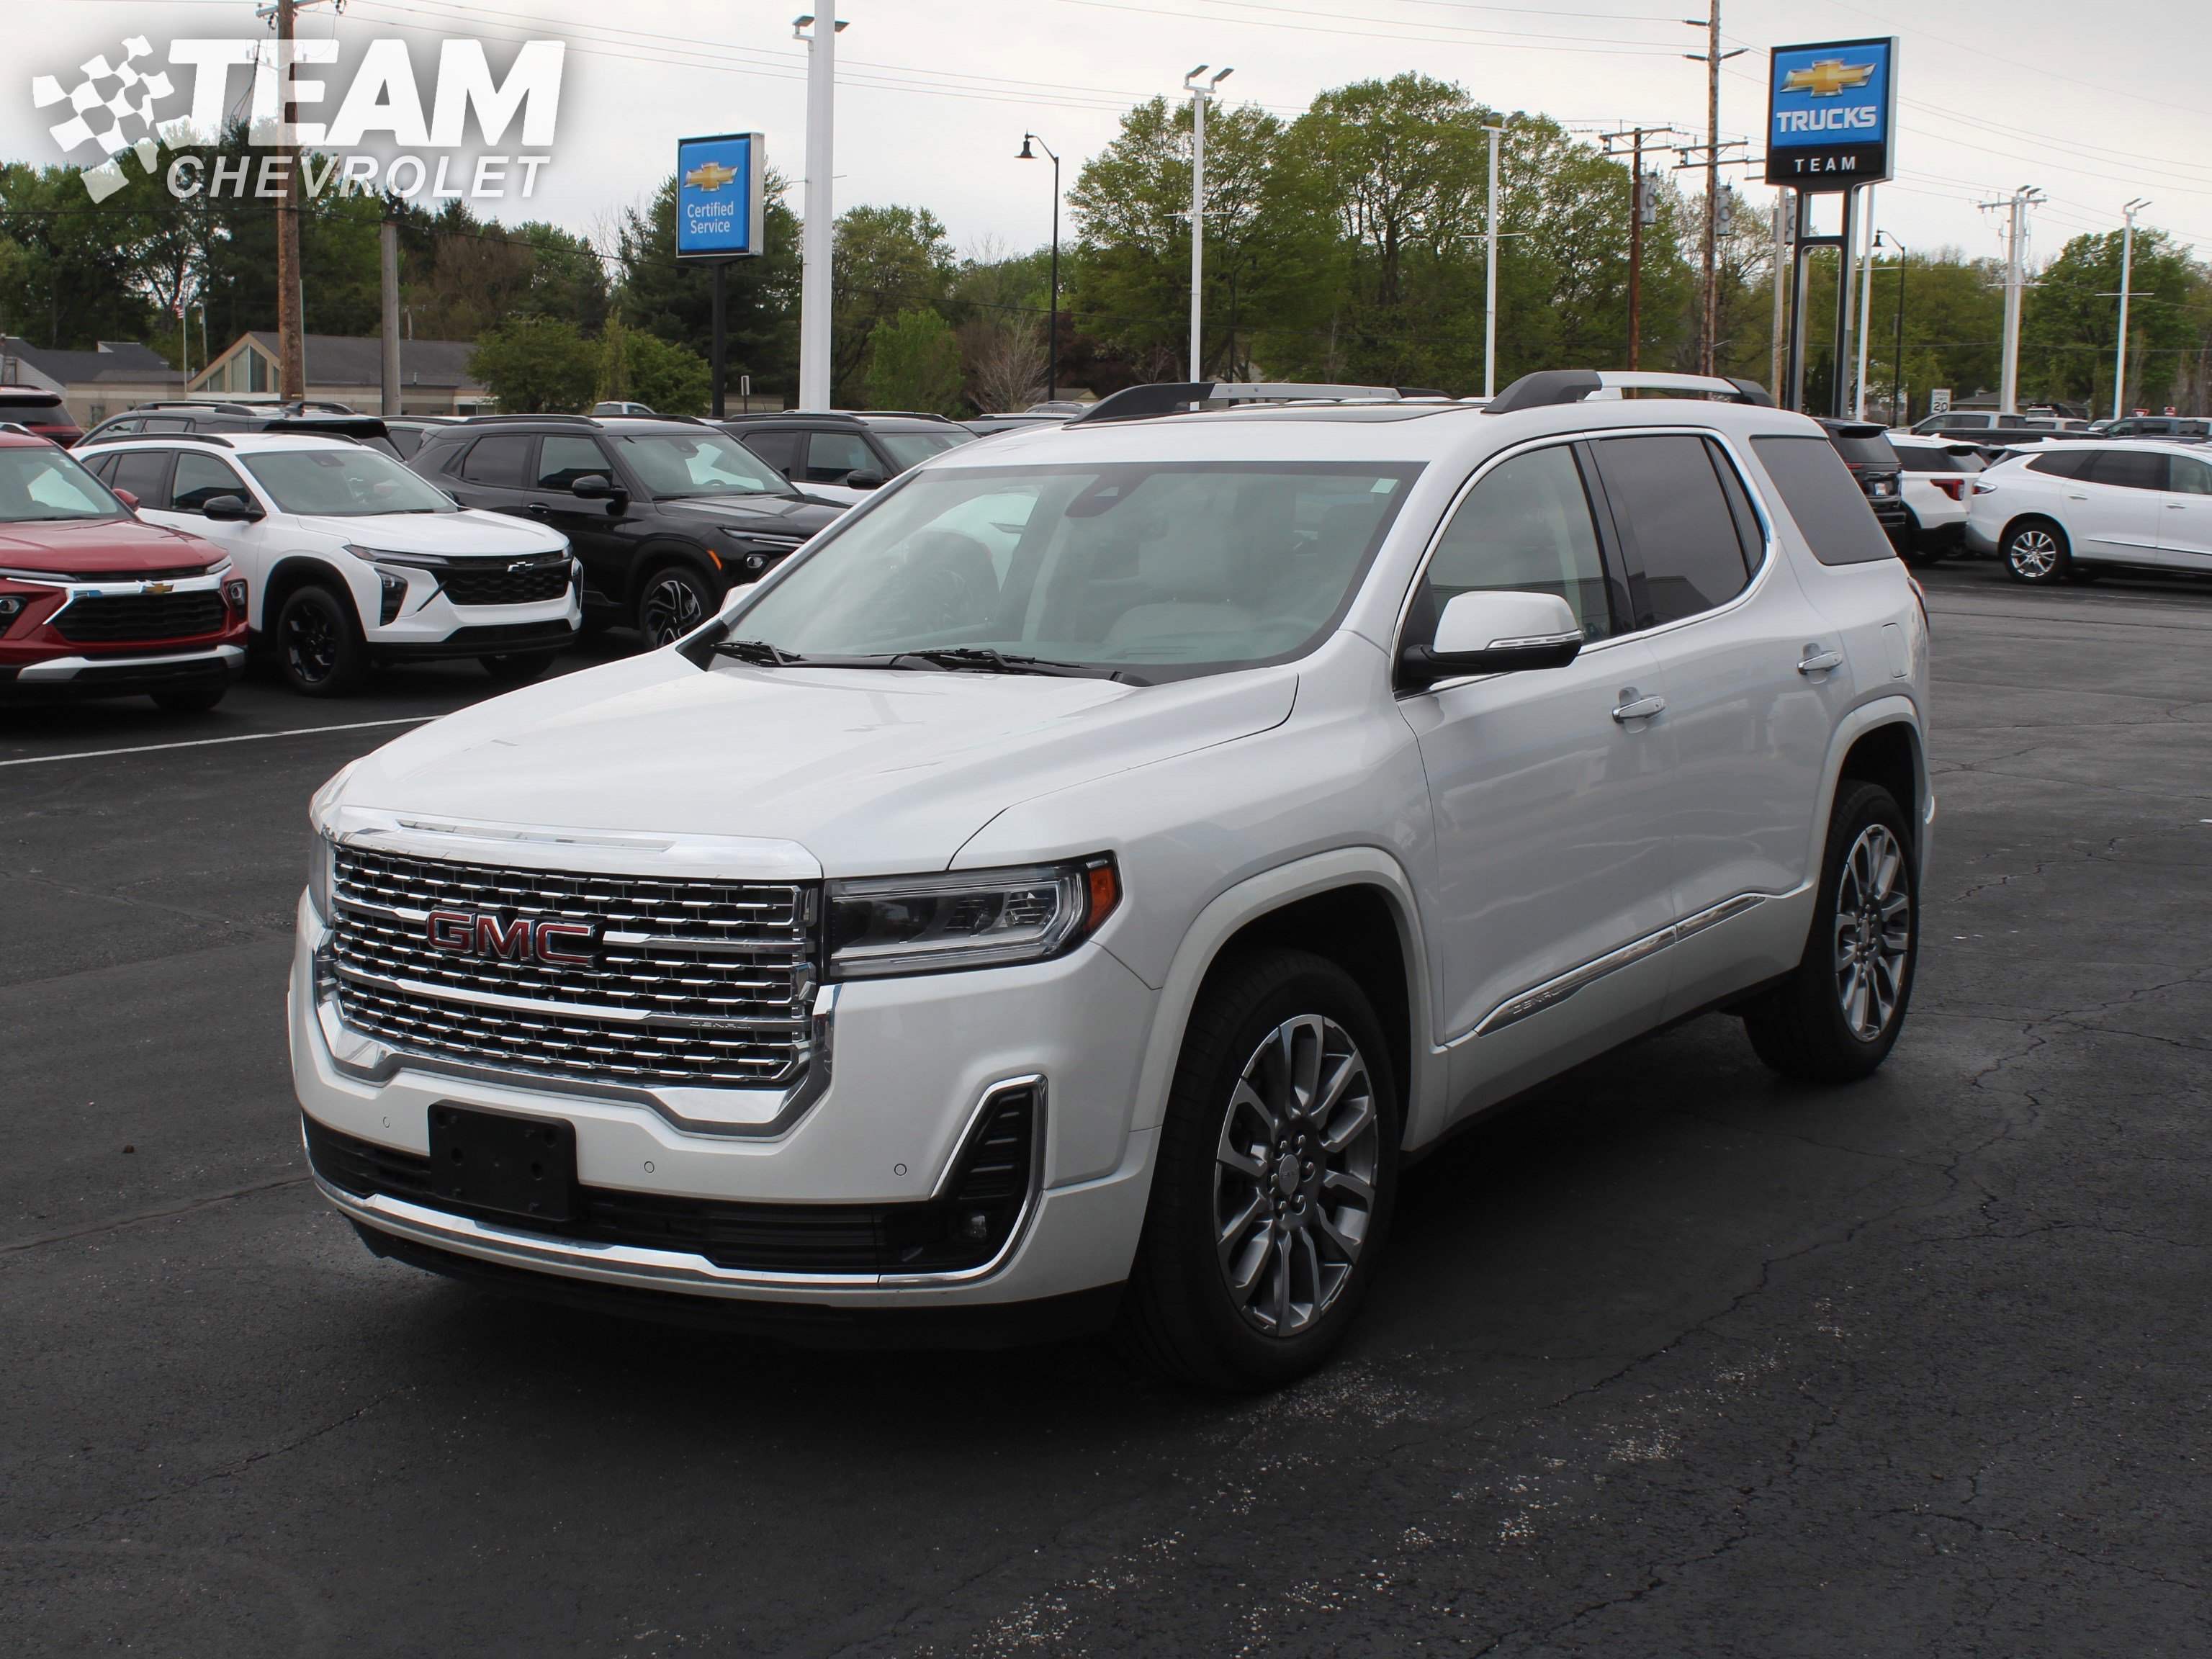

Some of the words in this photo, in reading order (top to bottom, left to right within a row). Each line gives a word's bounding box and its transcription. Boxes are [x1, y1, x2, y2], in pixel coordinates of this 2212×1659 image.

[1776, 106, 1877, 133] TRUCKS
[1794, 156, 1856, 173] TEAM
[687, 201, 734, 217] Certified
[690, 219, 731, 234] Service
[1933, 402, 1948, 411] 20
[426, 909, 596, 968] GMC
[1513, 989, 1563, 1015] DENALI
[689, 1021, 752, 1030] DENALI
